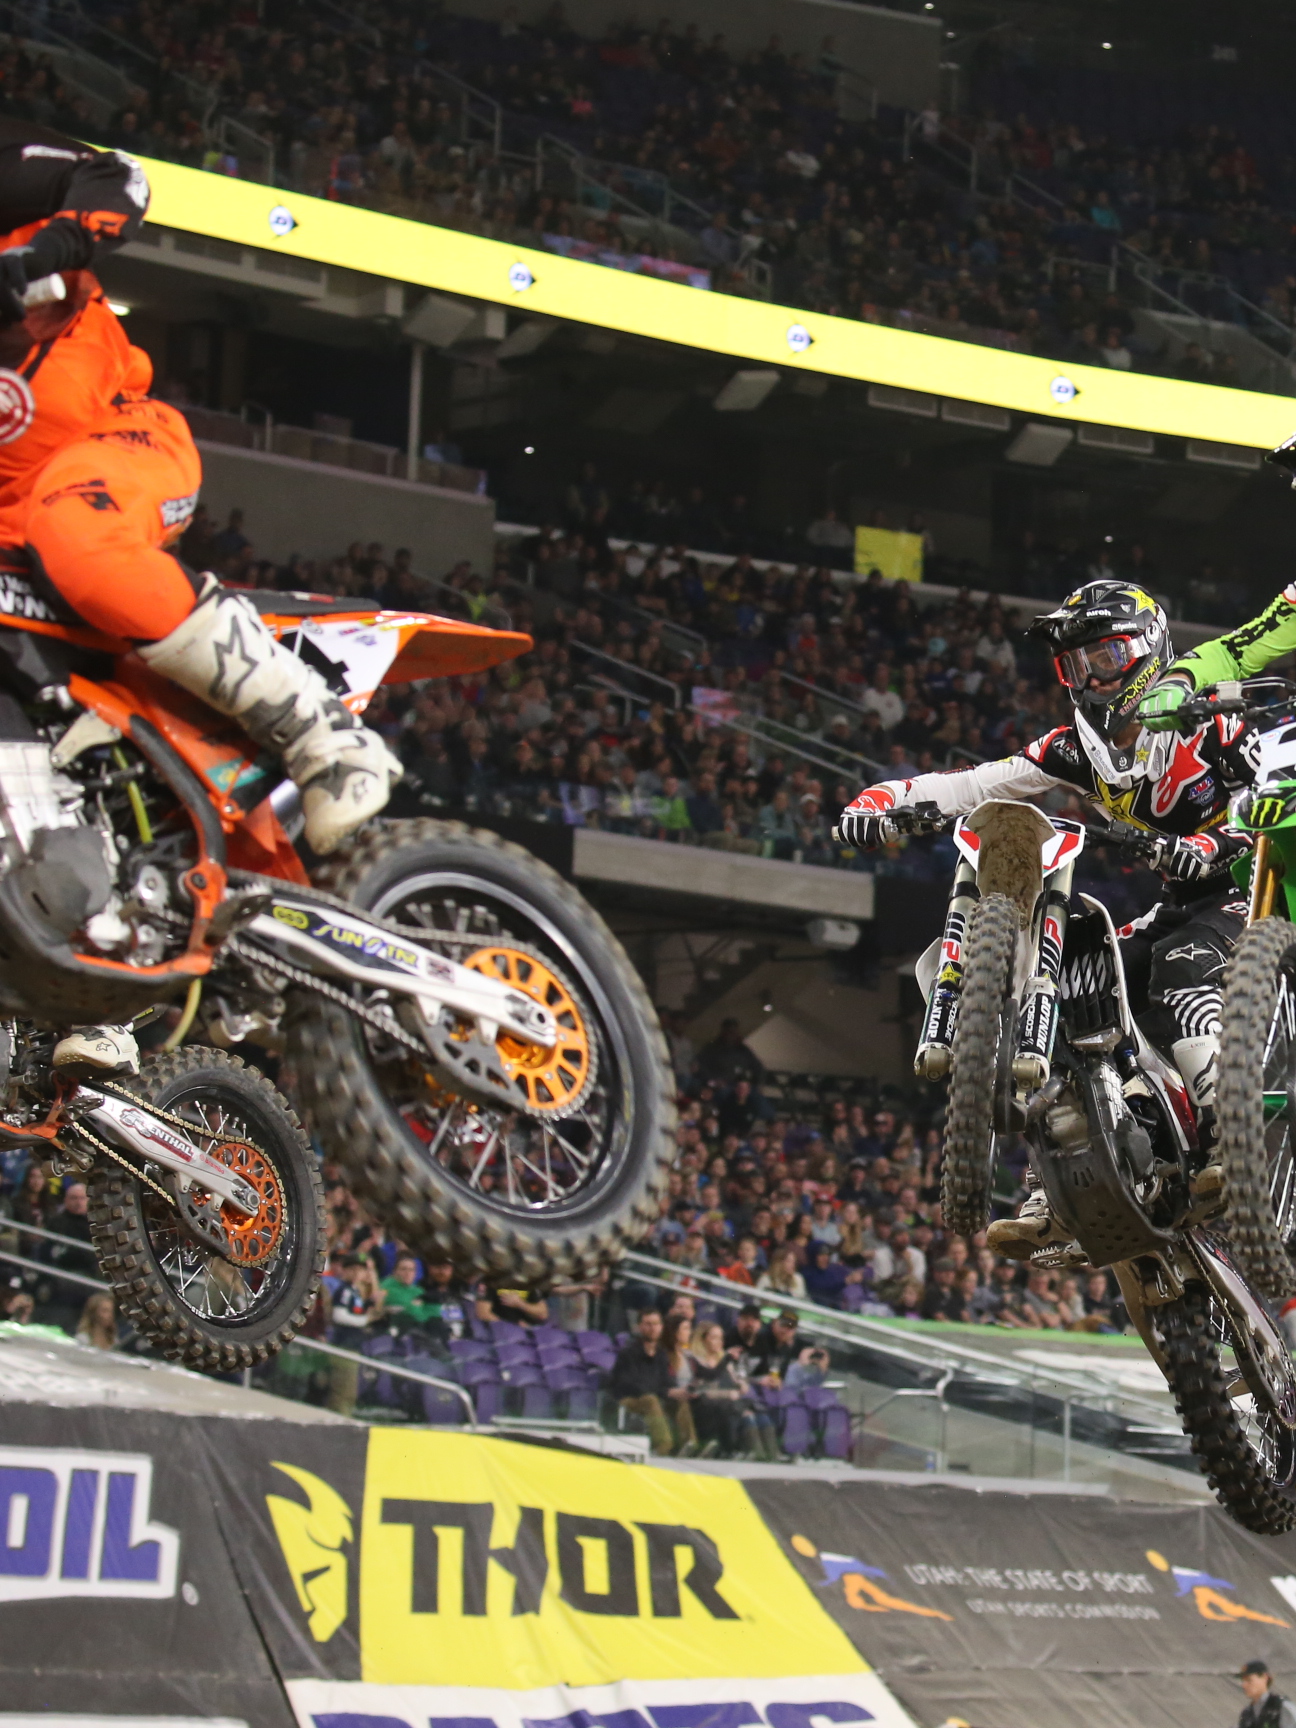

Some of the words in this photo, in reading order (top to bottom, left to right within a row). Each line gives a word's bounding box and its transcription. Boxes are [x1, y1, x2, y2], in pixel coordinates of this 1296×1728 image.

[1036, 996, 1053, 1053] DUNLOP
[380, 1497, 742, 1621] THOR
[966, 1566, 1008, 1590] THE
[1008, 1568, 1063, 1592] STATE
[1062, 1570, 1097, 1593] OF
[1099, 1571, 1154, 1595] SPORT
